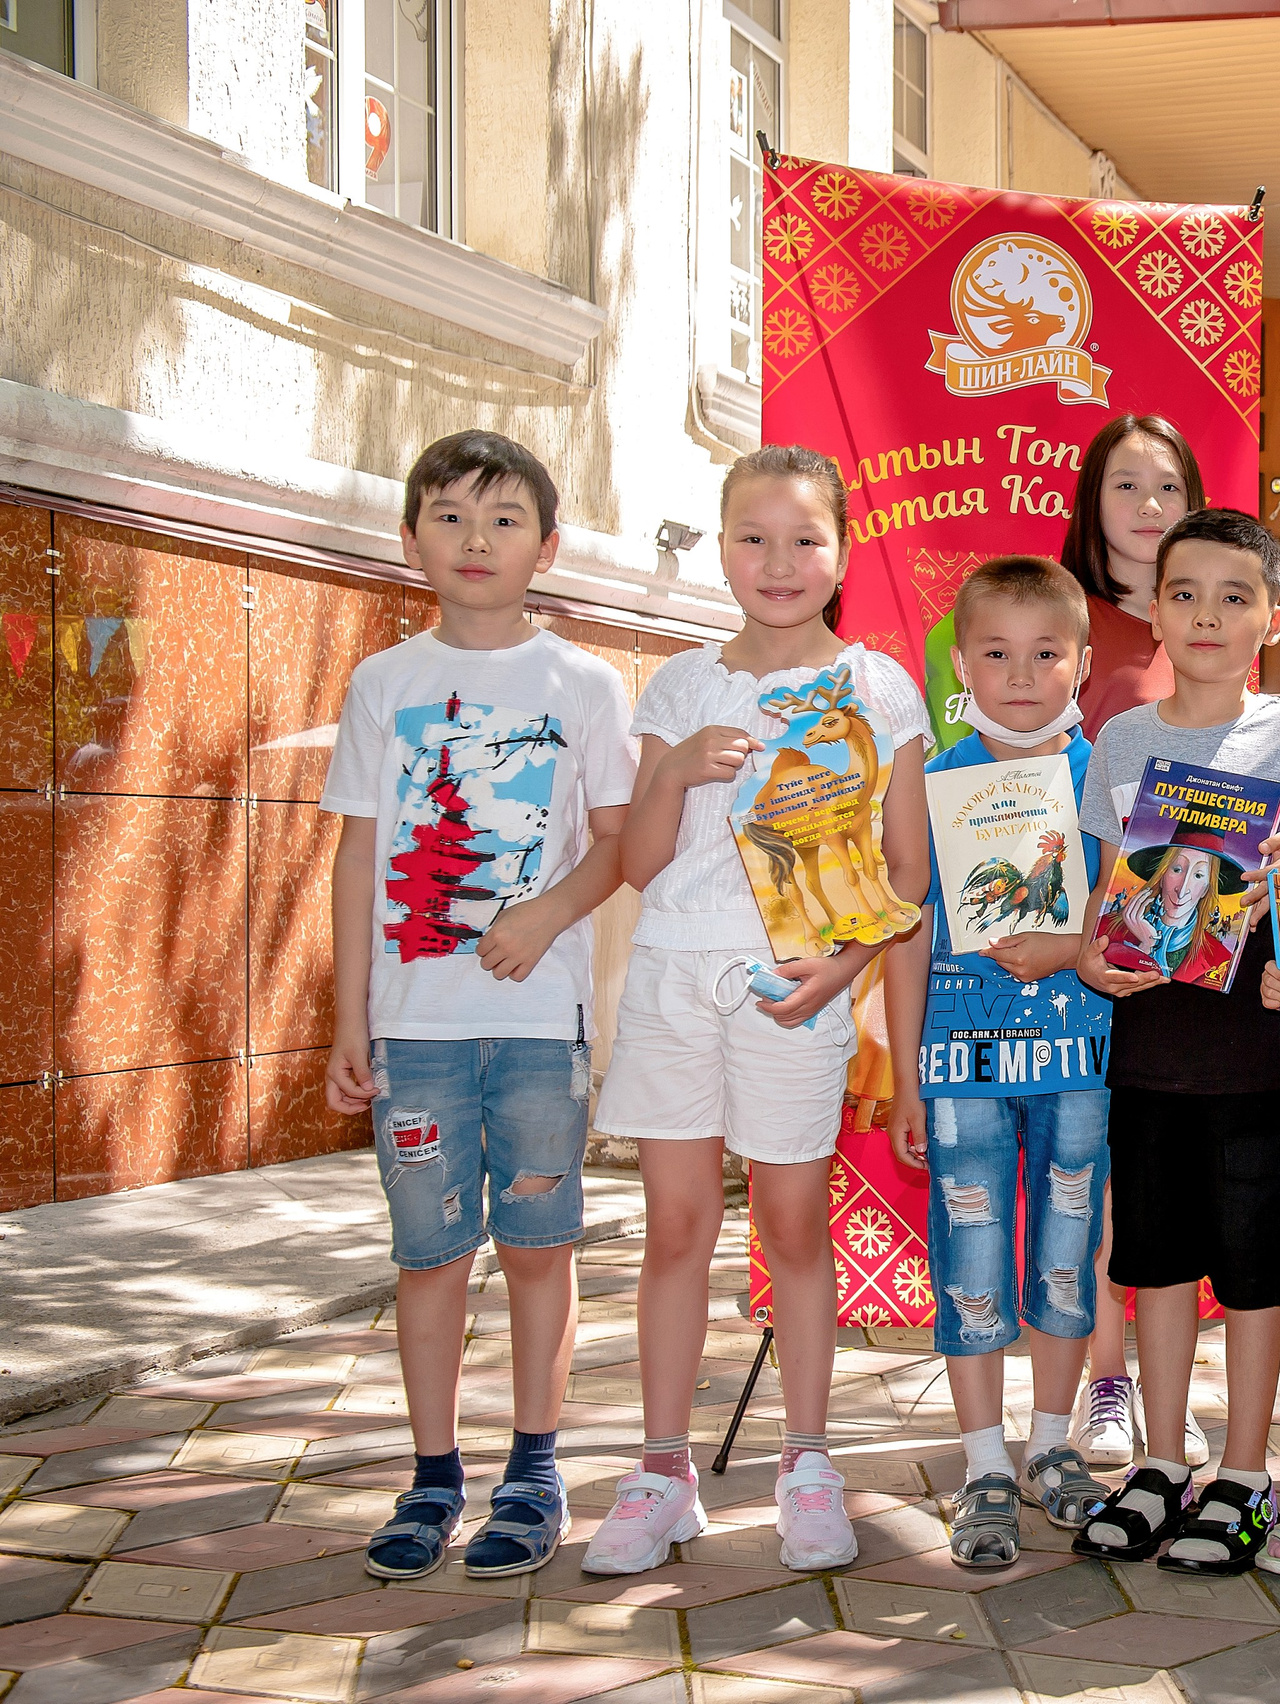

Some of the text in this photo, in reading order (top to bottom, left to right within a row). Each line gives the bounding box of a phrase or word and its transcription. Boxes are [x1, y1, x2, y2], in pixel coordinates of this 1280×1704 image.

[958, 350, 1079, 389] ШИН-ЛАЙН
[1186, 775, 1244, 793] Джонатан Свифт
[1153, 781, 1268, 817] ПУТЕШЕСТВИЯ
[772, 813, 811, 831] Почему
[814, 798, 860, 816] верблюд
[1158, 803, 1248, 835] ГУЛЛИВЕРА
[791, 832, 822, 847] когда
[975, 820, 1048, 841] БУРАТИНО
[1005, 1028, 1041, 1038] BRANDS
